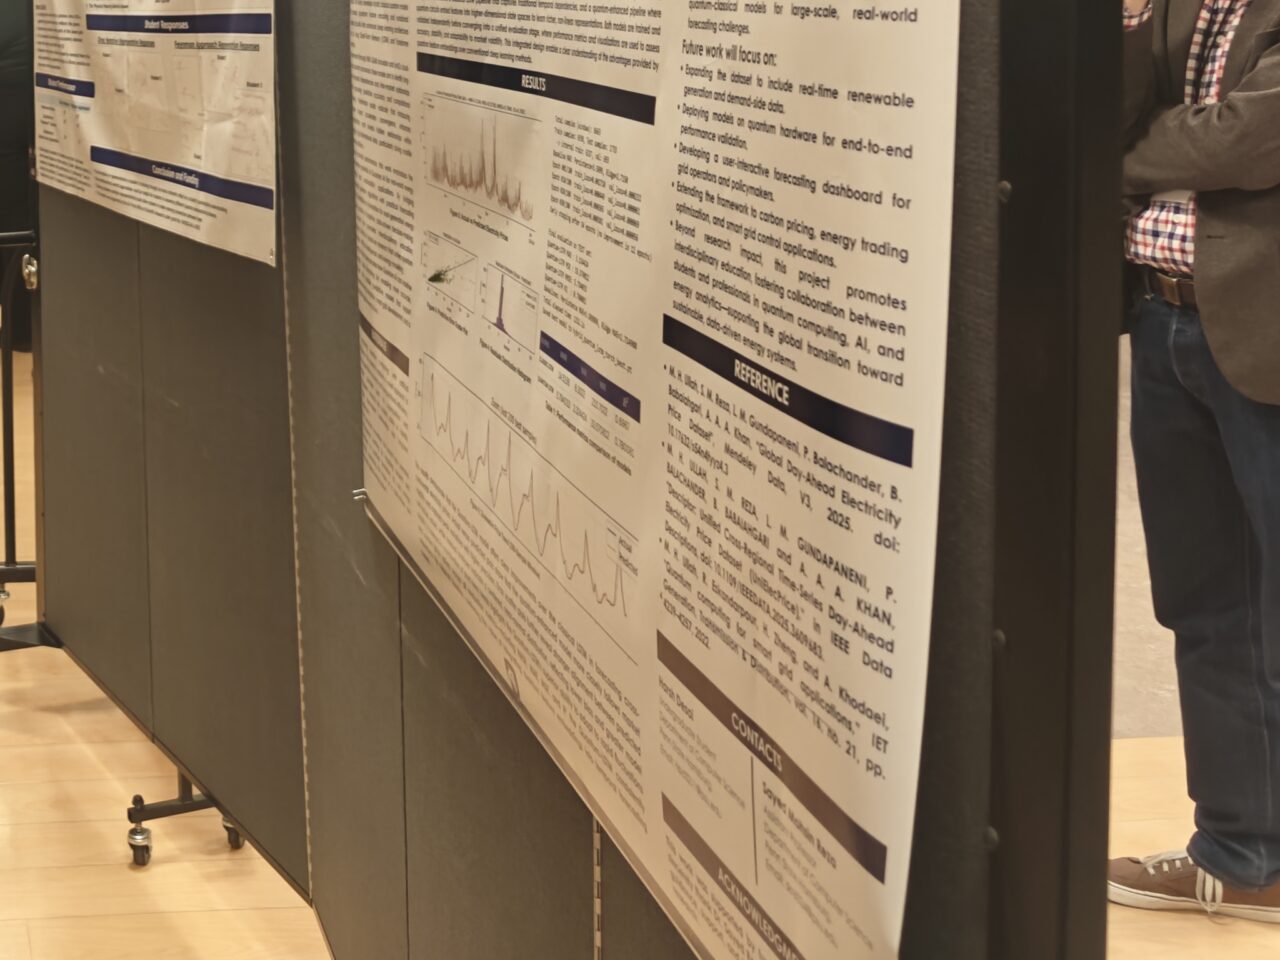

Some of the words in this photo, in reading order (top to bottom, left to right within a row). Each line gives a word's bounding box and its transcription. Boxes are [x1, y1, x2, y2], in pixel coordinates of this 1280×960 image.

[852, 7, 918, 23] real-world
[682, 39, 704, 57] Future
[705, 43, 723, 59] work
[725, 43, 737, 61] will
[739, 45, 761, 65] focus
[763, 52, 777, 67] on:
[521, 74, 546, 92] RESULTS
[768, 76, 793, 93] include
[799, 81, 839, 100] real-time
[847, 89, 915, 108] renewable
[748, 118, 777, 136] quantum
[780, 122, 817, 144] hardware
[822, 130, 836, 147] for
[841, 137, 913, 159] end-to-end
[774, 167, 817, 194] forecasting
[822, 180, 883, 205] dashboard
[892, 192, 912, 211] for
[717, 192, 749, 215] framework
[760, 208, 784, 228] carbon
[820, 228, 857, 252] energy
[861, 237, 910, 264] trading
[726, 219, 743, 234] smart
[757, 230, 782, 249] control
[783, 241, 837, 268] applications.
[704, 231, 732, 252] research
[774, 257, 787, 275] this
[798, 268, 831, 290] project
[846, 284, 908, 312] promotes
[754, 271, 785, 300] fostering
[787, 286, 845, 319] collaboration
[849, 307, 907, 337] between
[743, 334, 765, 358] energy
[762, 298, 794, 324] quantum
[877, 342, 906, 362] and
[778, 326, 803, 352] global
[807, 338, 851, 370] transition
[857, 361, 905, 387] toward
[734, 358, 790, 406] REFERENCE
[786, 461, 836, 499] Day-Ahead
[841, 489, 902, 529] Electricity
[813, 449, 885, 499] Balachander,
[828, 604, 895, 654] Day-Ahead
[831, 631, 850, 655] IEEE
[862, 650, 893, 679] Data
[731, 711, 783, 773] CONTACTS
